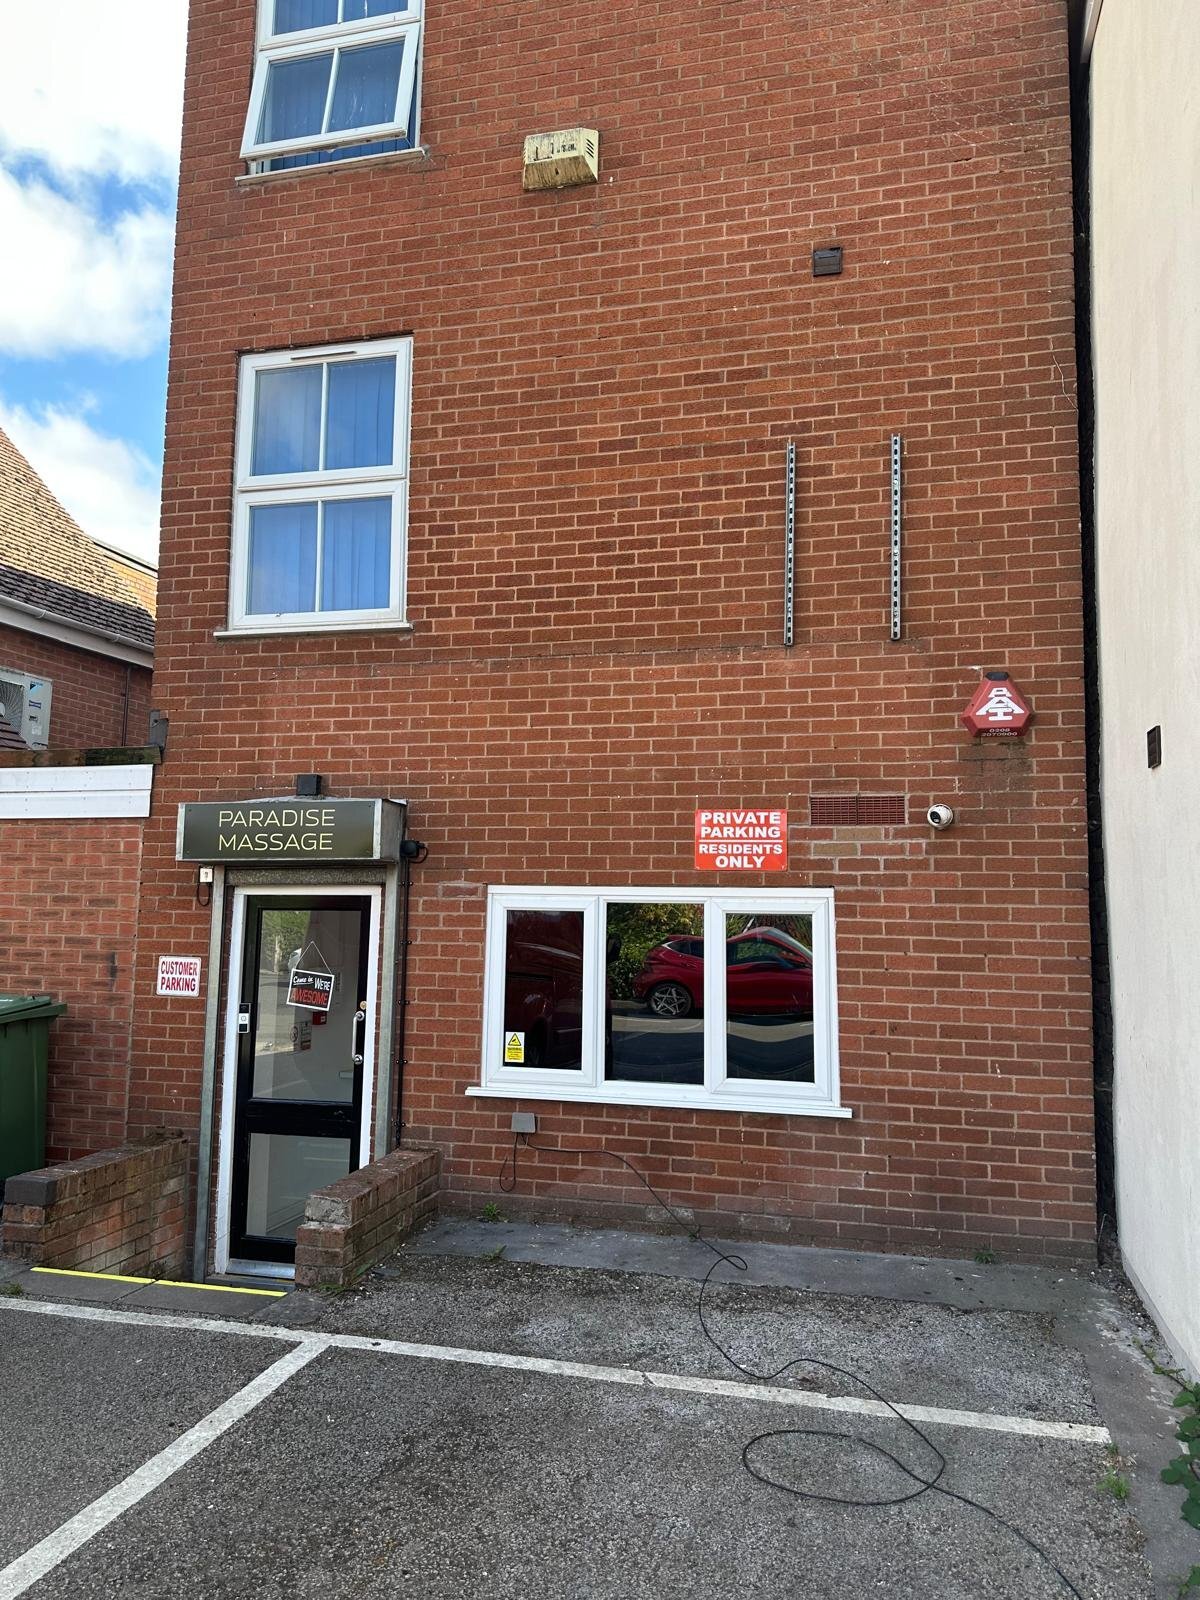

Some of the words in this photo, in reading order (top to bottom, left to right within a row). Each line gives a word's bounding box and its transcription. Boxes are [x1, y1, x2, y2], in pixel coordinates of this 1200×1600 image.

[219, 809, 336, 827] PARADISE
[701, 812, 781, 824] PRIVATE
[701, 826, 781, 838] PARKING
[219, 833, 334, 851] MASSAGE
[699, 844, 783, 854] RESIDENTS
[715, 855, 766, 868] ONLY
[160, 961, 198, 976] CUSTOMER
[160, 976, 196, 992] PARKING
[290, 988, 328, 1005] AWESOME
